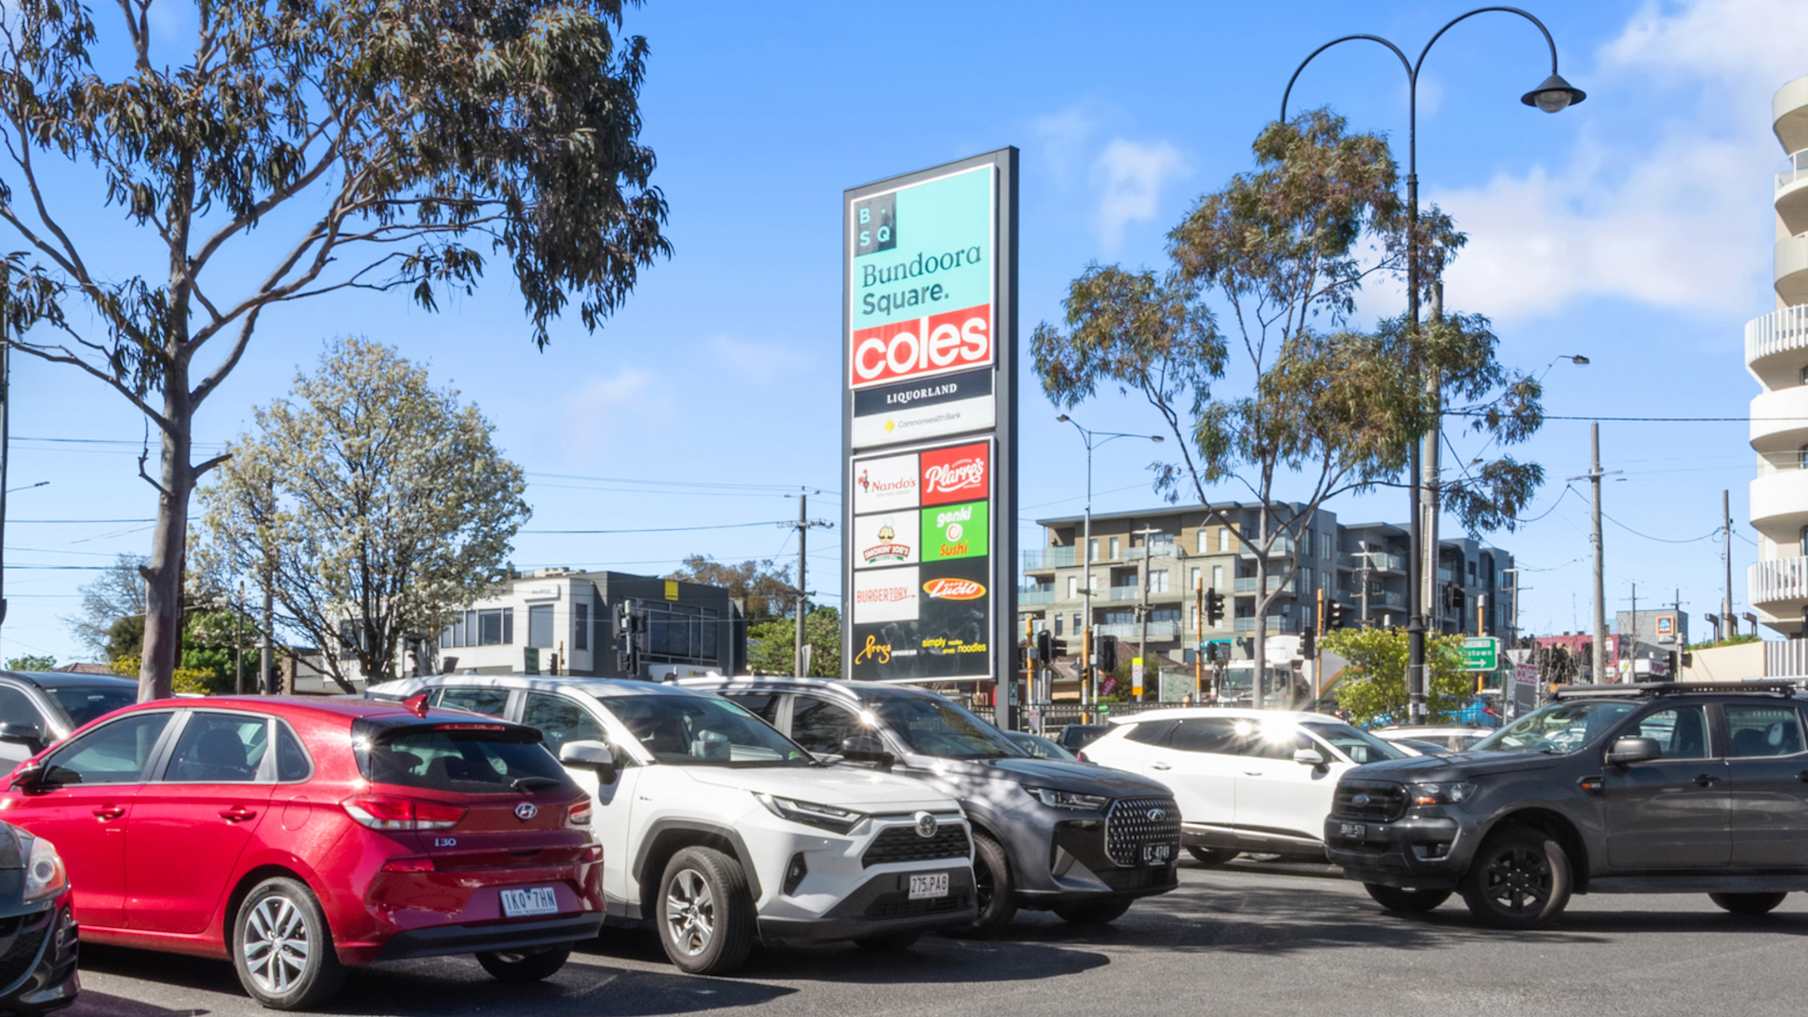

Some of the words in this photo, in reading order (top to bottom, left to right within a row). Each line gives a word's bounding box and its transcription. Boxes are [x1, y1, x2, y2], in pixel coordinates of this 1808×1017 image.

[862, 245, 982, 288] Bundoora
[862, 283, 950, 316] Square.
[855, 317, 988, 379] coles
[886, 383, 958, 404] LIQUORLAND
[871, 477, 916, 492] Nando's
[939, 542, 968, 556] Sushi
